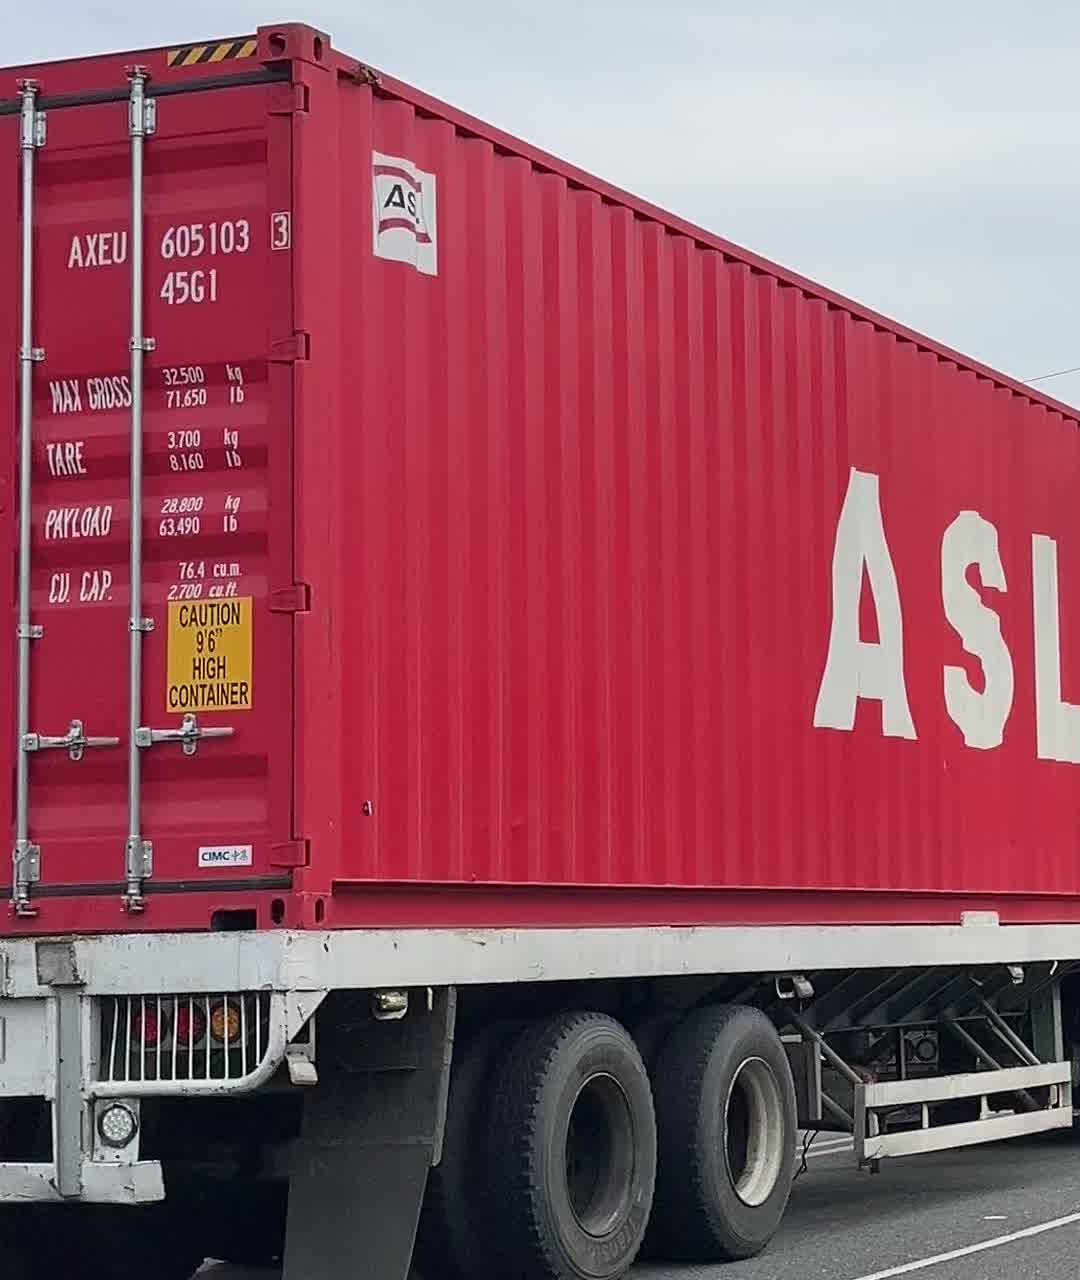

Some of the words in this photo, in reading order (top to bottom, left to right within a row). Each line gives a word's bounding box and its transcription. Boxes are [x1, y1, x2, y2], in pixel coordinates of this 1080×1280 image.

[68, 231, 127, 269] AXEU
[160, 219, 250, 259] 605103
[274, 214, 288, 247] 3
[160, 269, 217, 305] 45G1
[226, 364, 243, 384] kg
[50, 379, 82, 414] MAX
[87, 375, 132, 411] GROSS
[230, 386, 244, 404] lb
[224, 427, 239, 449] kg
[46, 441, 87, 477] TARE
[226, 451, 242, 468] lb
[225, 495, 241, 513] kg
[45, 505, 112, 540] PAYLOAD
[223, 515, 238, 533] lb
[178, 561, 205, 580] 76.4
[49, 572, 71, 604] CU.
[80, 570, 112, 602] CAP.
[179, 602, 241, 627] CAUTION
[192, 656, 226, 680] HIGH
[168, 681, 249, 709] CONTAINER
[201, 851, 230, 861] CIMC
